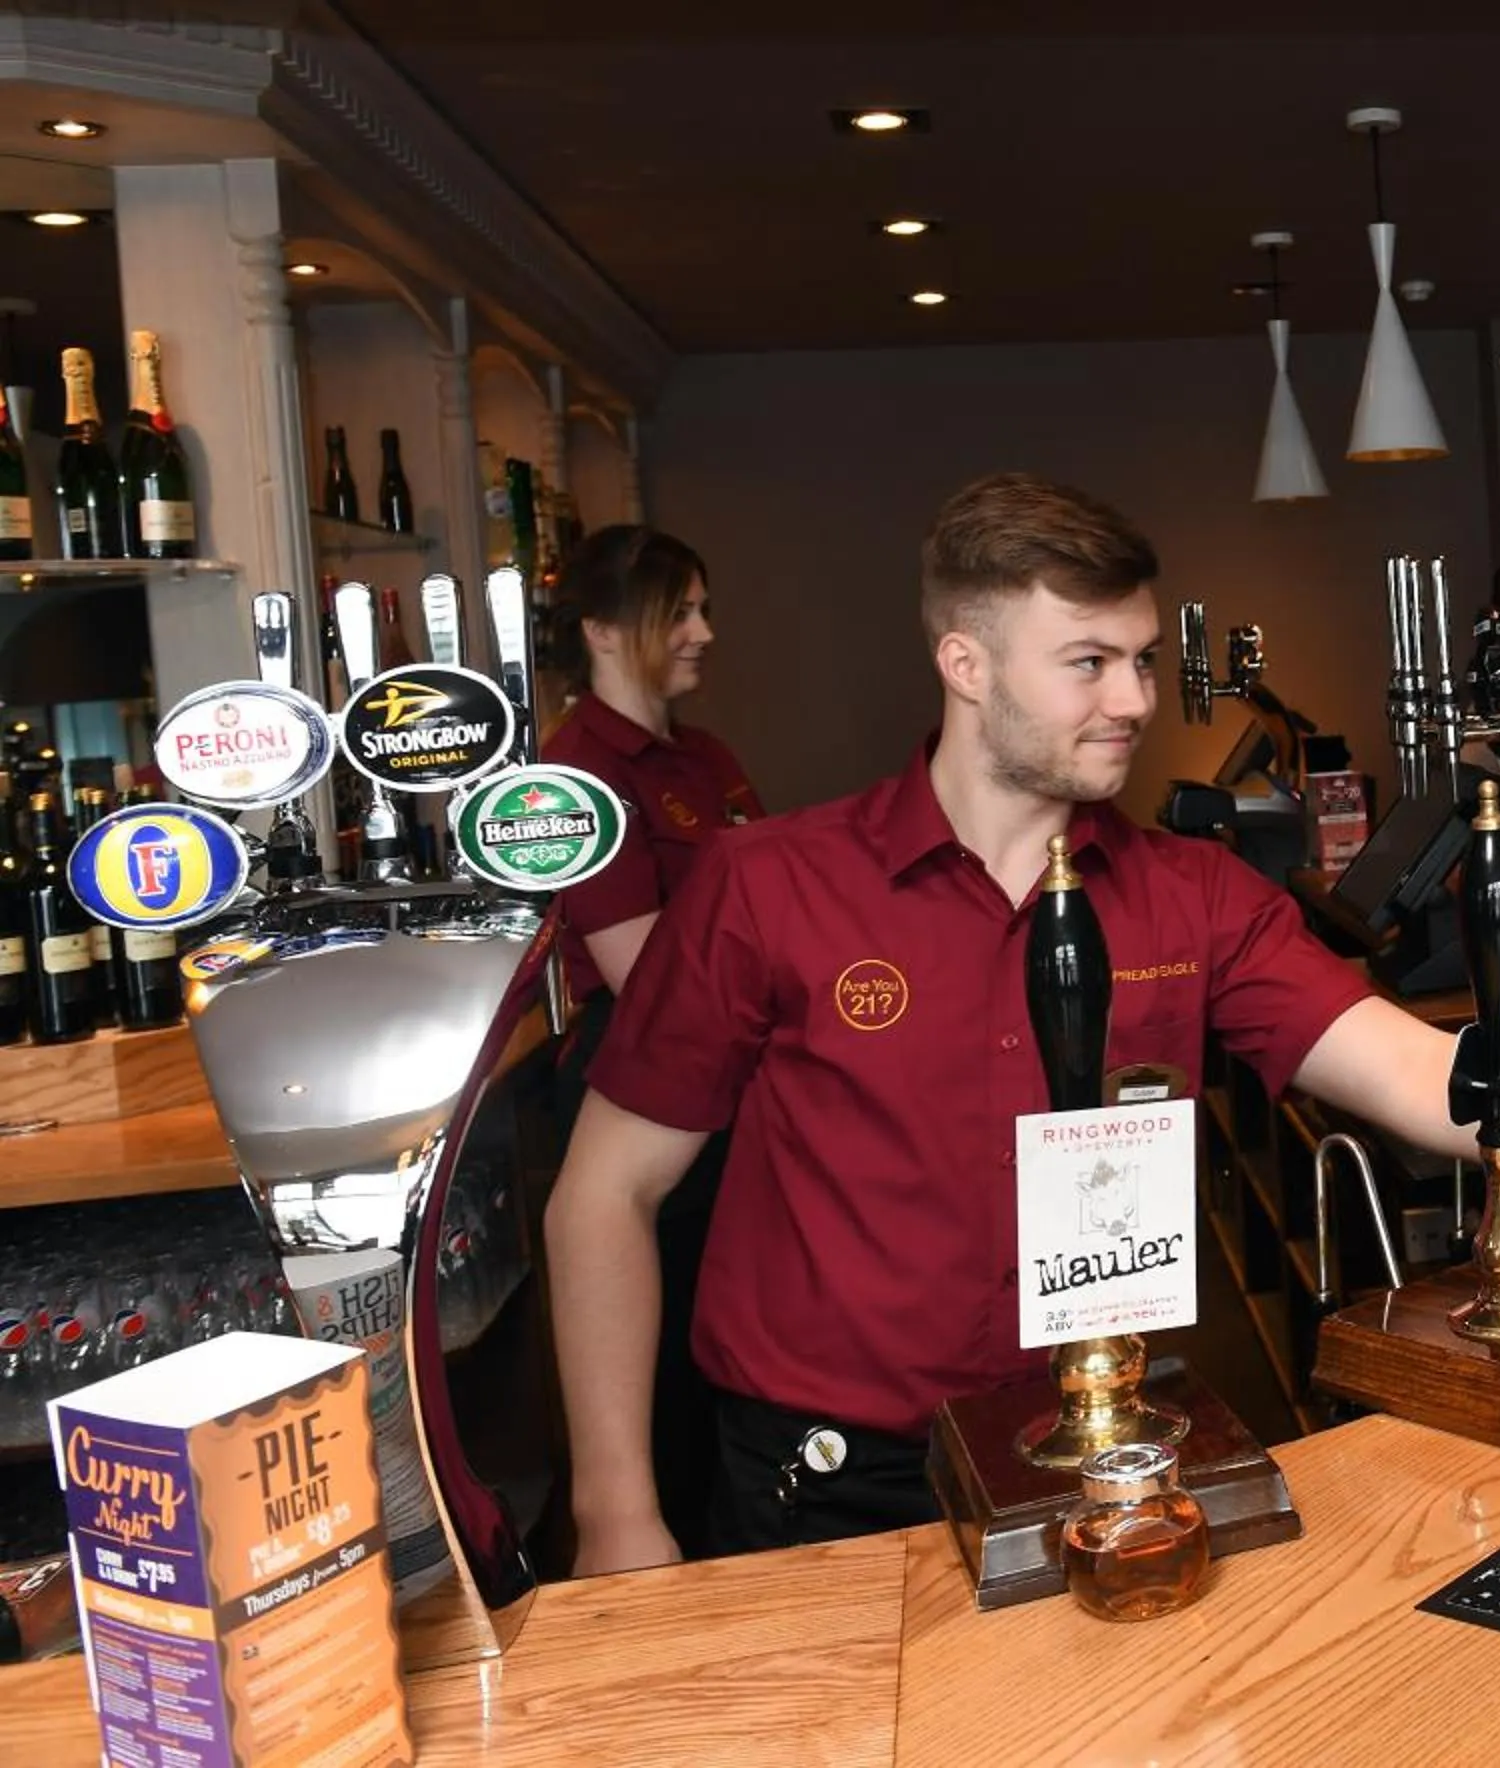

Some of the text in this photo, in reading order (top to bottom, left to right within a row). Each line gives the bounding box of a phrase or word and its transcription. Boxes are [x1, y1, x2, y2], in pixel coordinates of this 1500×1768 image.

[175, 723, 288, 761] PERONI
[361, 721, 488, 760] STRONGBOW
[389, 749, 470, 769] ORIGINAL
[180, 748, 292, 773] NASTRO AZZURRO
[484, 813, 592, 844] Heineken
[130, 840, 174, 897] F
[842, 978, 900, 995] Are You
[850, 993, 893, 1017] 21?
[1043, 1117, 1173, 1145] RINGWOOD
[1033, 1232, 1184, 1297] Mauler
[67, 1425, 187, 1531] Curry
[94, 1498, 161, 1547] Night
[264, 1475, 331, 1536] NIGHT
[243, 1573, 310, 1617] Thursdays
[338, 1543, 365, 1568] 5pm
